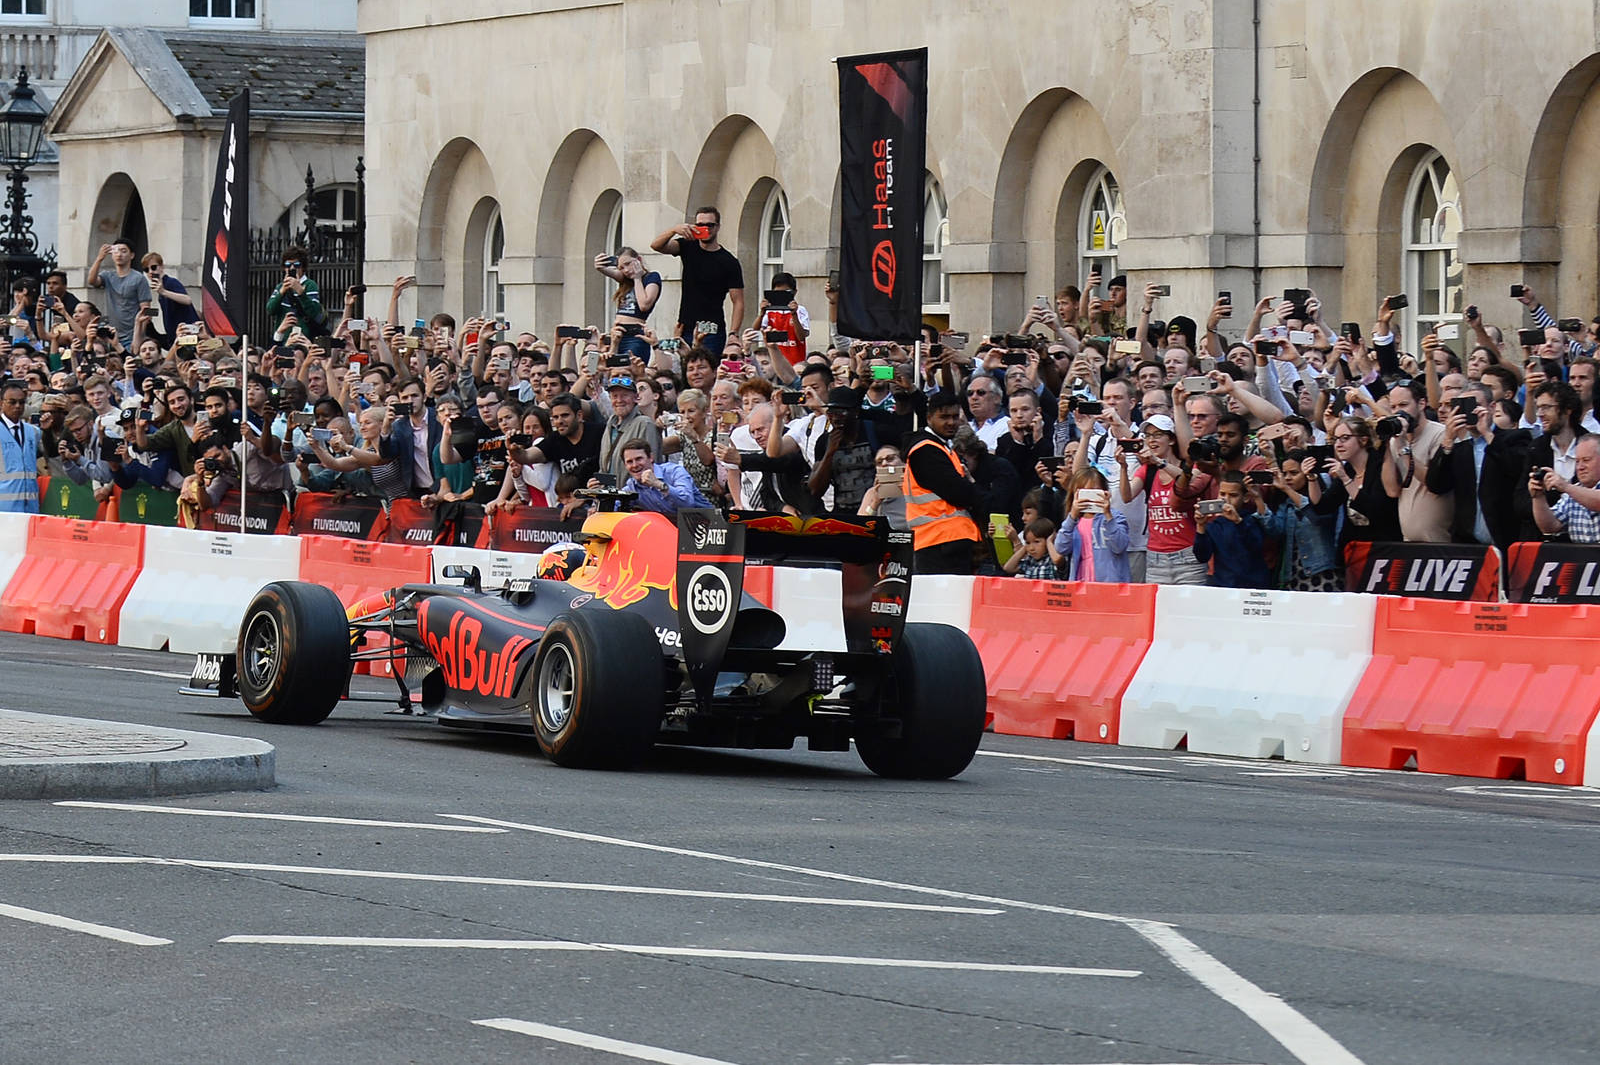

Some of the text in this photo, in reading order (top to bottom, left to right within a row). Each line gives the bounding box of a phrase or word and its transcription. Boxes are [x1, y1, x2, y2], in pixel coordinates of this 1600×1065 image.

[872, 138, 888, 230] Haas
[312, 518, 361, 534] F1LIVELONDON
[515, 529, 572, 543] F1LIVELONDON
[706, 528, 728, 546] AT&T
[1404, 558, 1474, 592] LIVE
[694, 583, 726, 612] Esso
[458, 615, 535, 698] Bull
